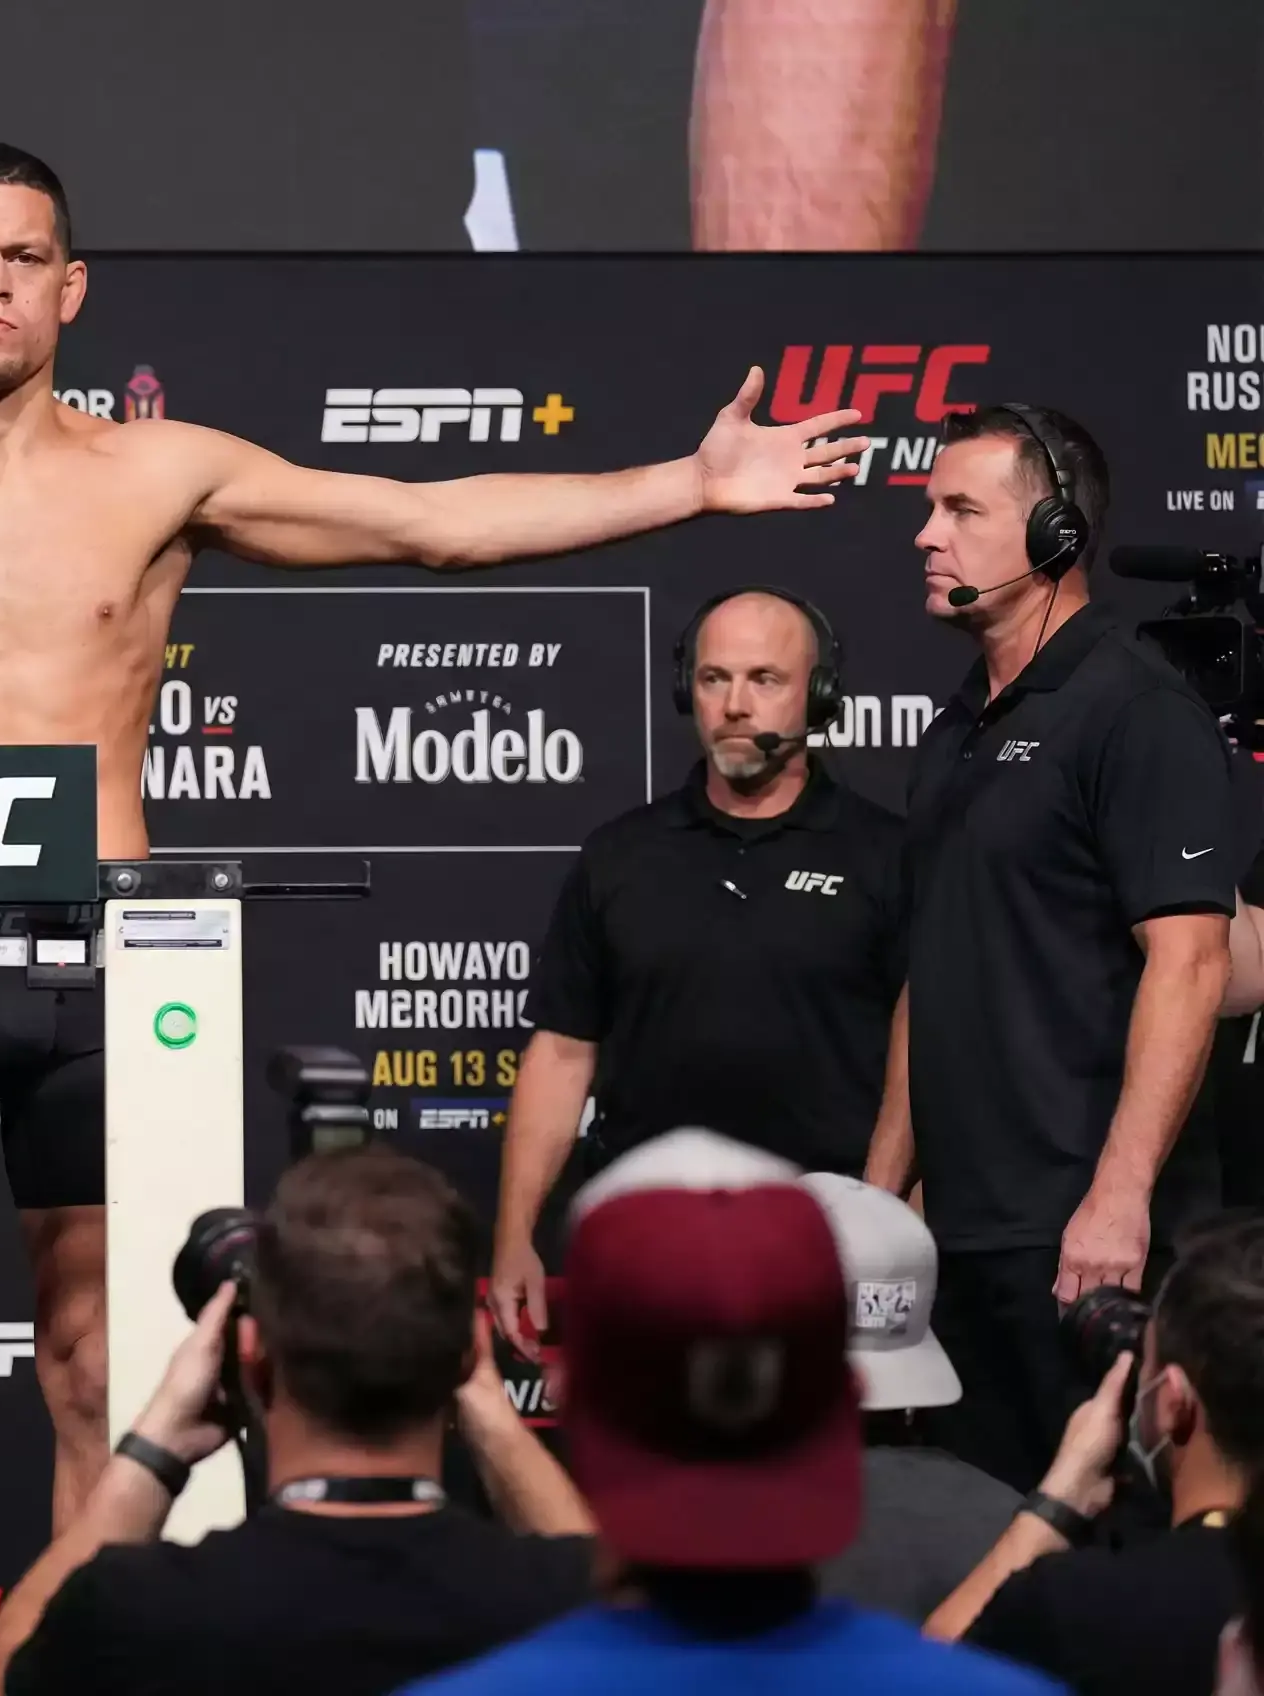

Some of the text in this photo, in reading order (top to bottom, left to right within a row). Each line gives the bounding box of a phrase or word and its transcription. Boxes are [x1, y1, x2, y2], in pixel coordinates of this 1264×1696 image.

[1207, 324, 1264, 364] NO
[769, 345, 991, 424] UFC
[52, 389, 115, 421] OR
[891, 437, 946, 471] NI
[1206, 433, 1264, 469] ME
[1166, 490, 1205, 511] LIVE
[1210, 490, 1235, 511] ON
[377, 643, 563, 667] PRESENTED BY
[354, 706, 584, 784] Modelo
[996, 740, 1040, 762] UFC
[784, 870, 844, 896] UFC
[379, 940, 530, 981] HOWAYO
[372, 1051, 438, 1087] AUG
[449, 1051, 486, 1087] 13
[373, 1109, 399, 1130] ON
